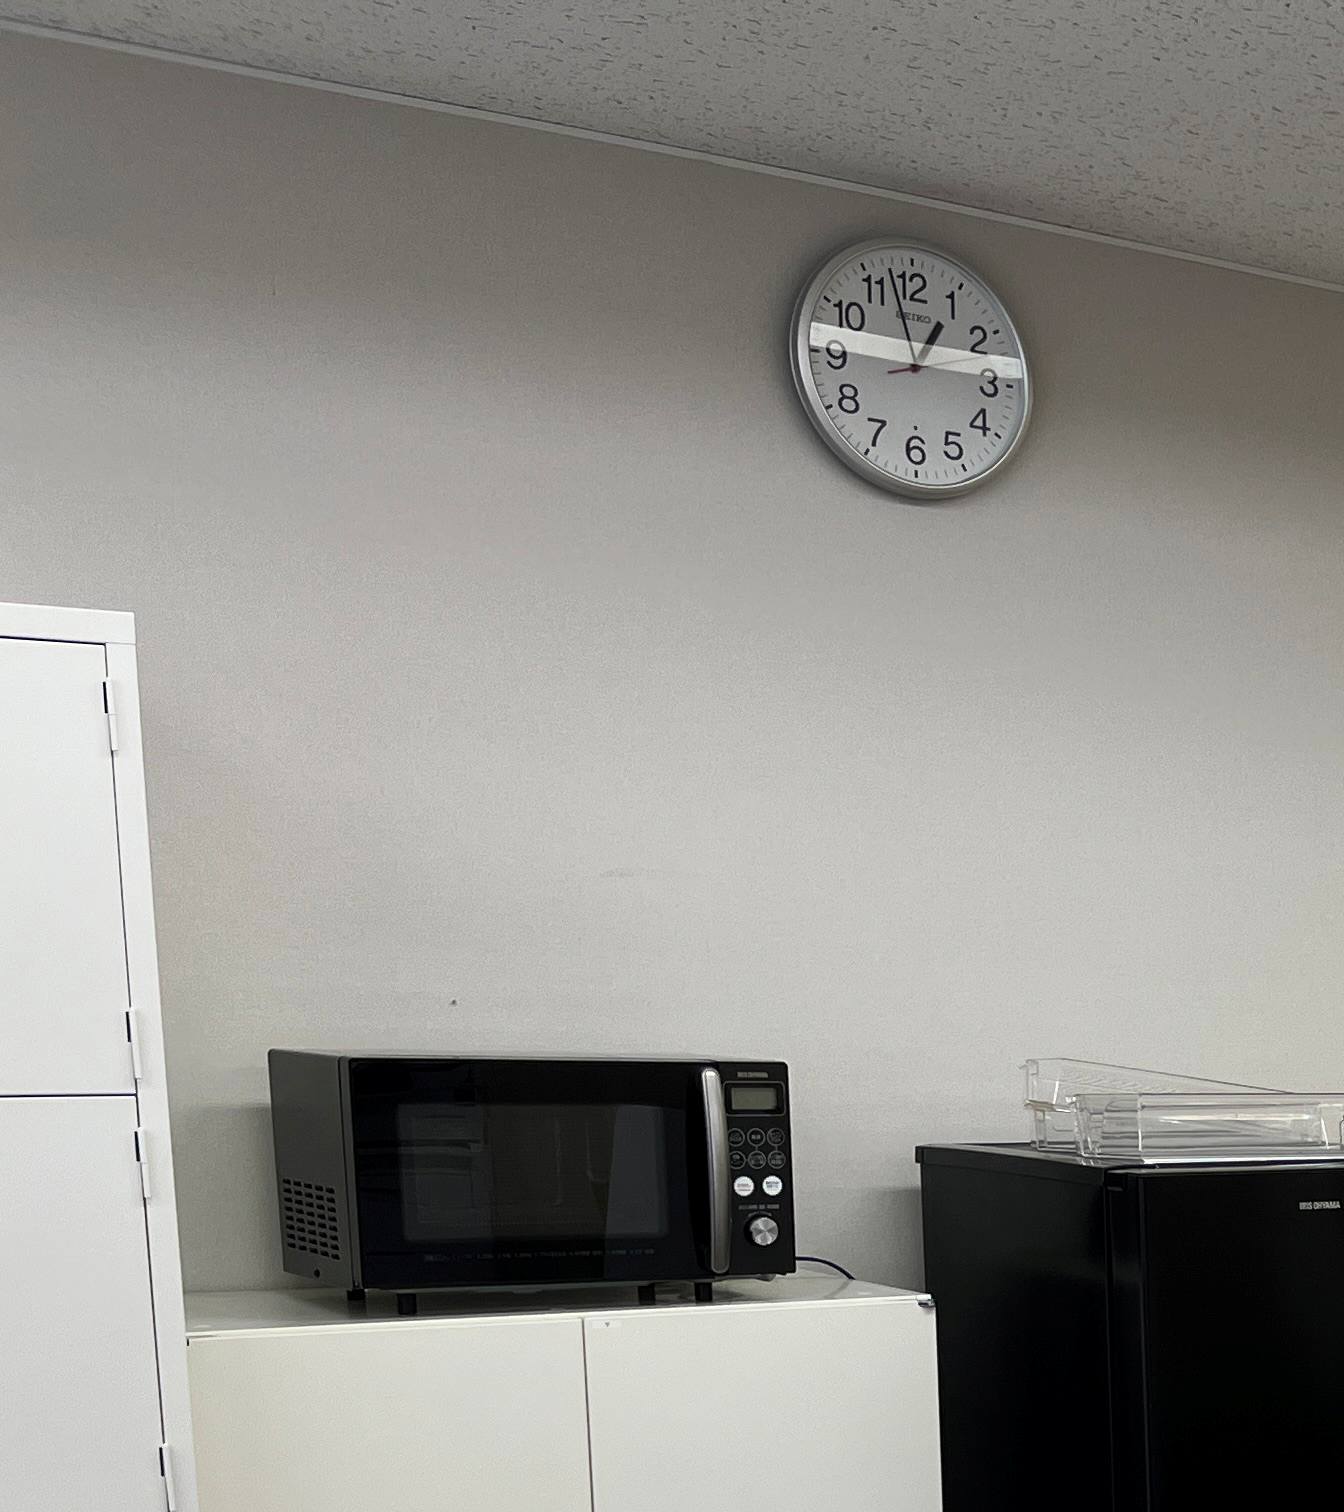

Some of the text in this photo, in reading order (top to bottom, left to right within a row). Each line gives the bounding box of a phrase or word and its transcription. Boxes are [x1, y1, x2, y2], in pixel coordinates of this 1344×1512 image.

[862, 274, 886, 306] 11
[896, 271, 928, 304] 12
[833, 299, 866, 332] 10
[945, 290, 956, 320] 1
[825, 339, 848, 370] 9
[969, 325, 989, 355] 2
[979, 367, 999, 398] 3
[837, 383, 860, 414] 8
[867, 417, 887, 447] 7
[969, 408, 992, 437] 4
[905, 435, 926, 465] 6
[943, 431, 964, 461] 5
